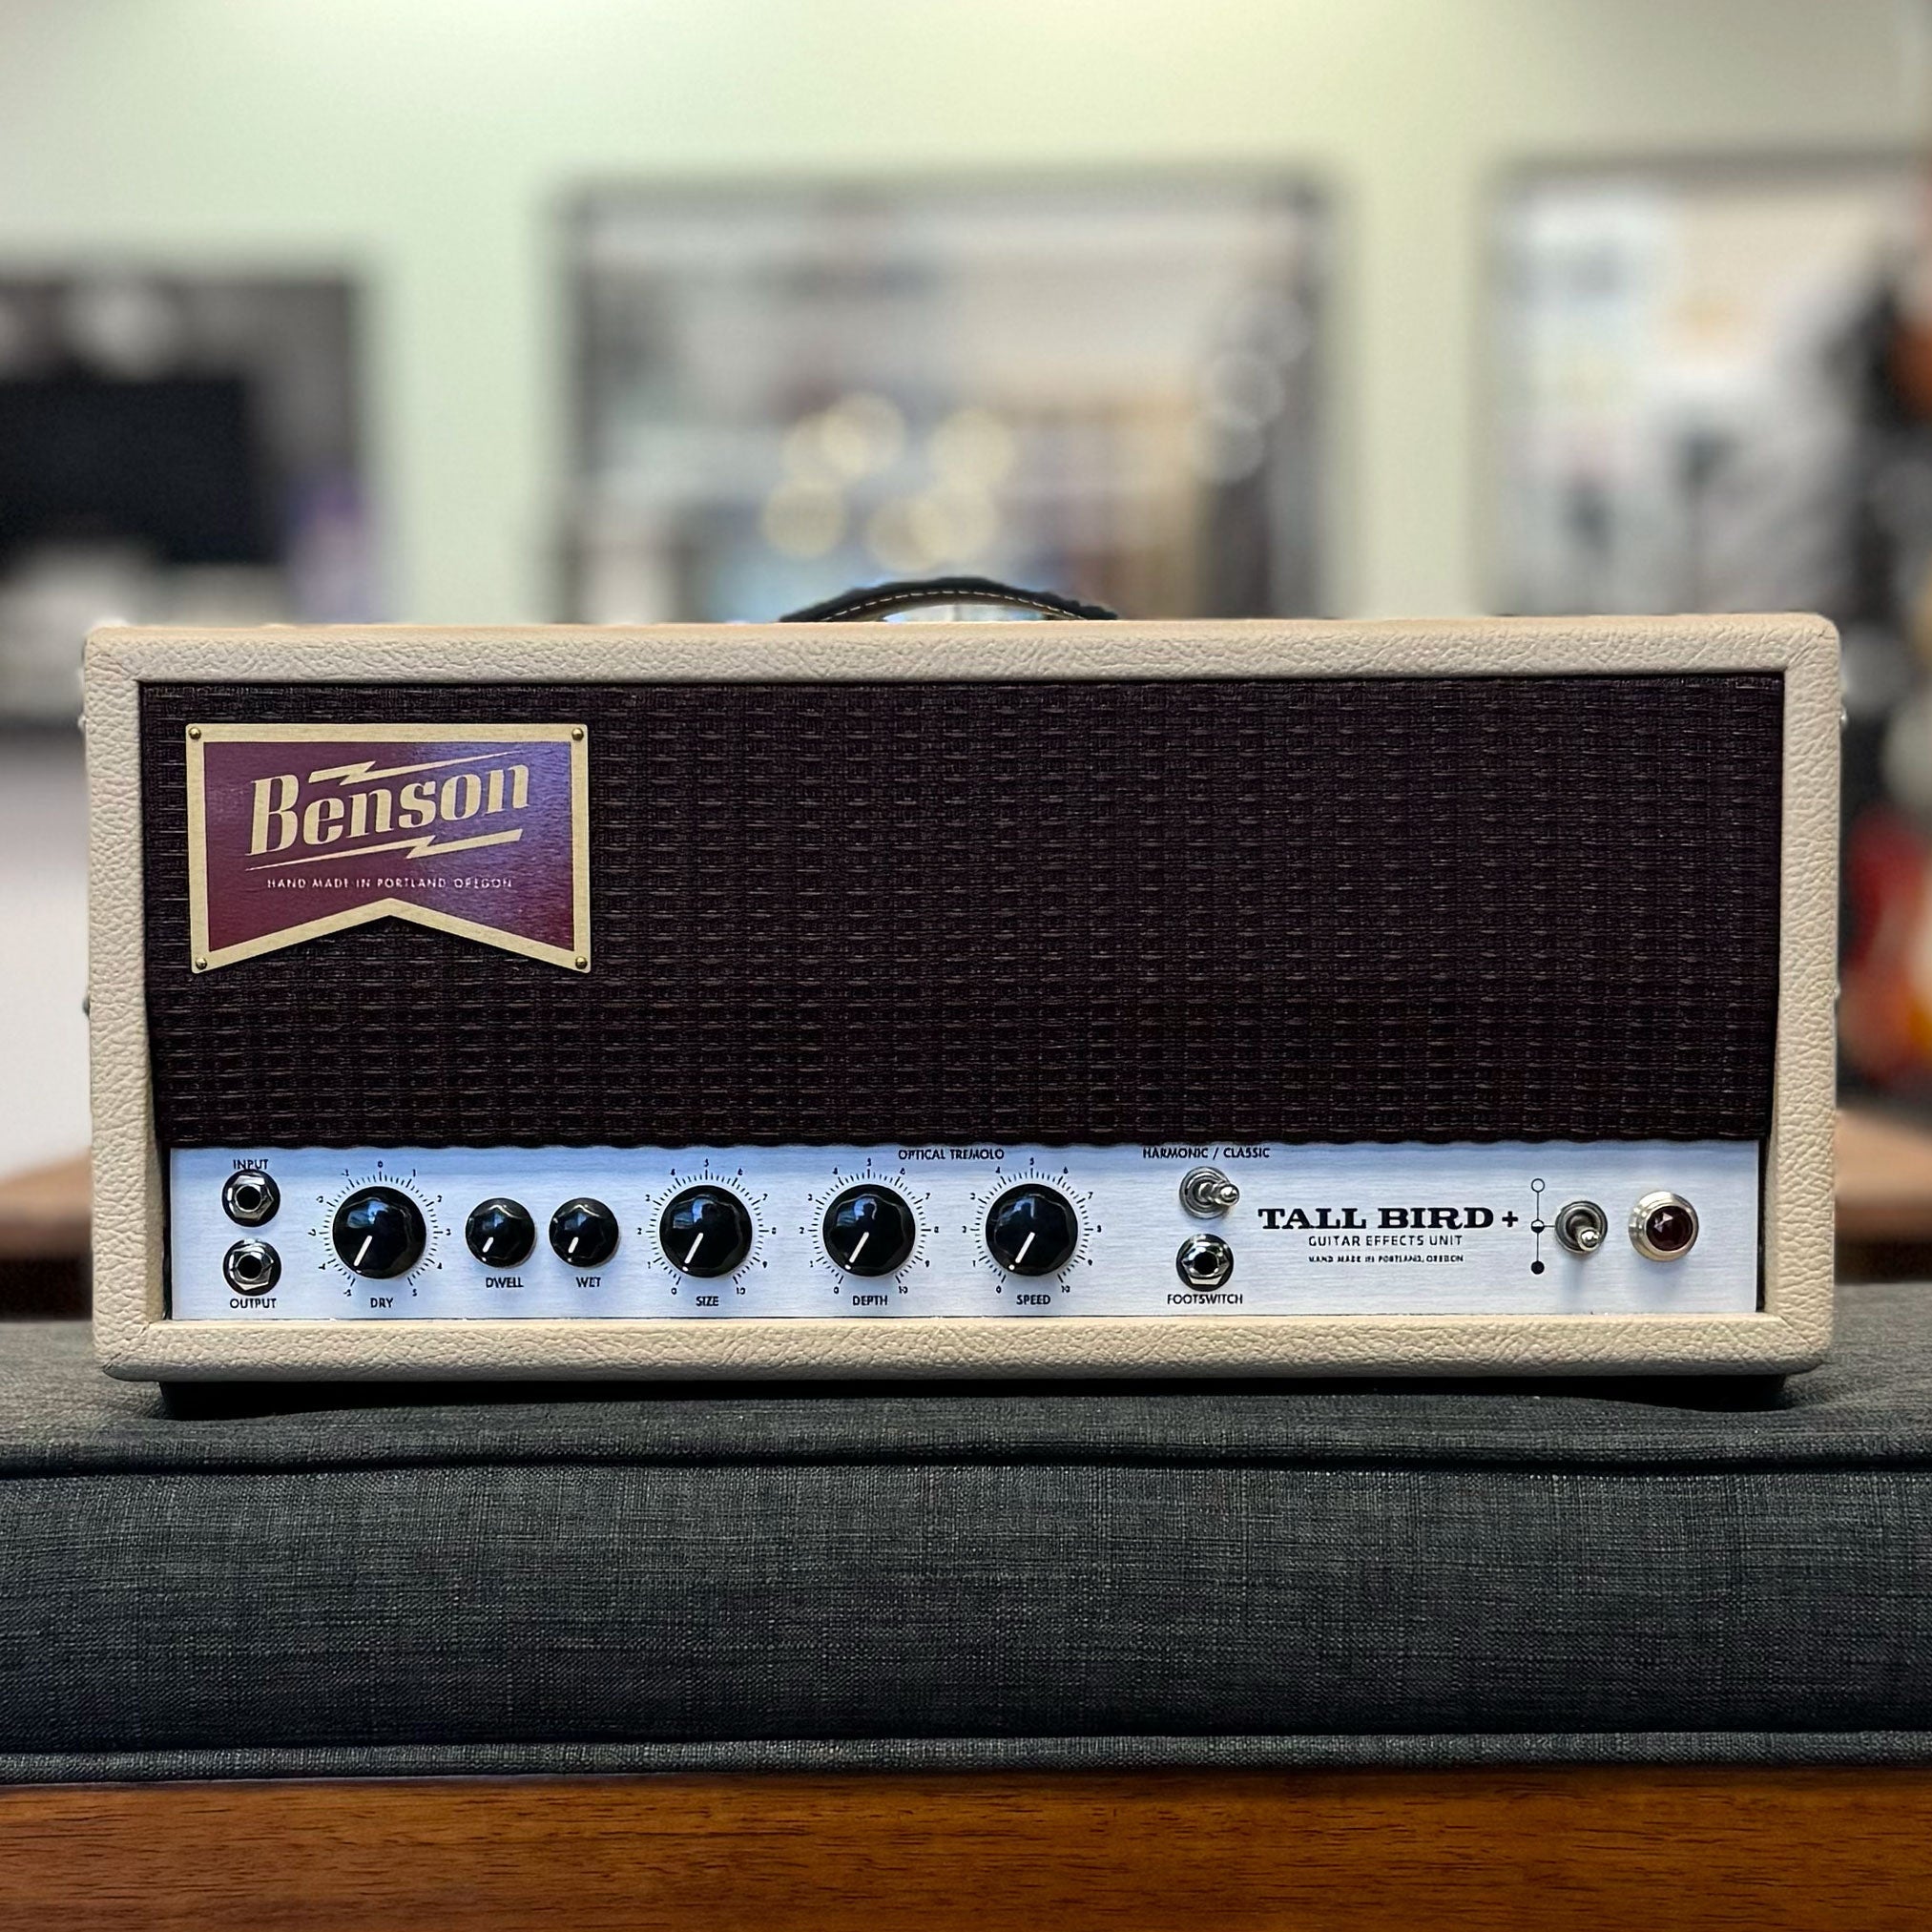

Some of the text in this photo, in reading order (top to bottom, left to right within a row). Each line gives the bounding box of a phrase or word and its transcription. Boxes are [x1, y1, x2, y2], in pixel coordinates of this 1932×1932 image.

[245, 764, 530, 857] Benson
[267, 879, 306, 888] HAND
[356, 878, 371, 888] IN
[377, 878, 447, 888] PORTLAND
[453, 878, 512, 888] OREGON
[899, 1148, 1005, 1160] OPTICAL TREMOLO
[1143, 1147, 1208, 1158] HARMONIC
[1223, 1147, 1271, 1158] CLASSIC
[233, 1159, 269, 1170] INPUT
[1258, 1208, 1366, 1229] TALL
[1309, 1236, 1462, 1246] GUITAR EFFECTS UNIT
[486, 1278, 524, 1288] DWELL
[576, 1277, 601, 1287] WET
[230, 1298, 276, 1308] OUTPUT
[370, 1298, 393, 1308] DRY
[696, 1296, 718, 1306] SIZE
[853, 1295, 887, 1305] DEPTH
[1017, 1295, 1050, 1305] SPEED
[1168, 1294, 1242, 1304] FOOTSWITCH
